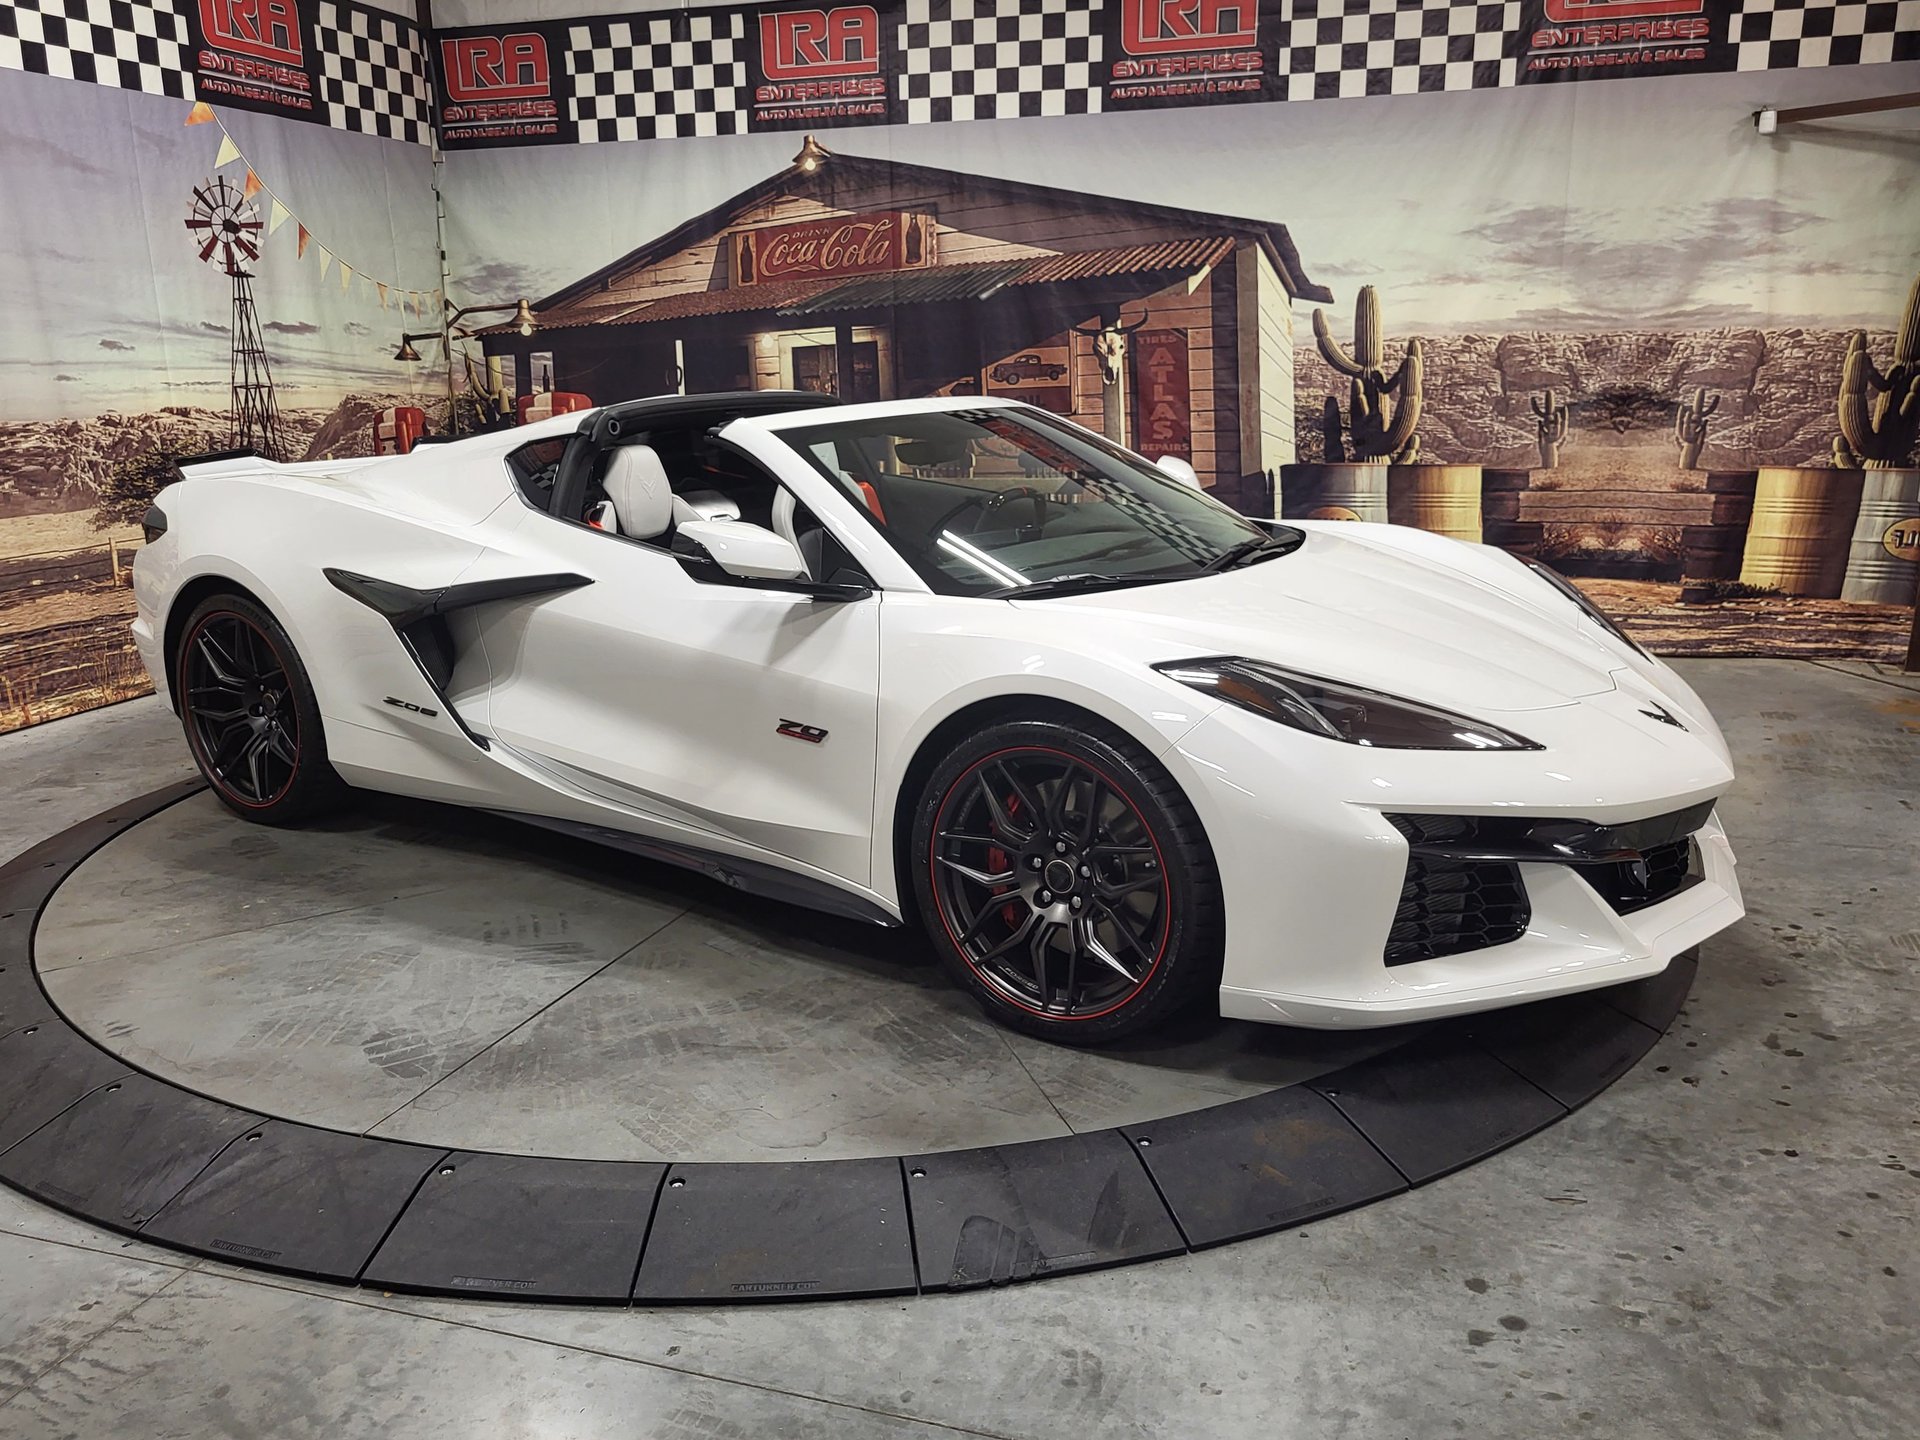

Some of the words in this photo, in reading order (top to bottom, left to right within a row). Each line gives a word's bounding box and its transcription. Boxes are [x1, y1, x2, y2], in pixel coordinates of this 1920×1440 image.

[758, 5, 880, 81] LRA
[1531, 18, 1710, 48] ENTERPRISES
[198, 50, 310, 90] ENTERPRISES
[441, 32, 551, 102] LRA
[1112, 51, 1263, 78] ENTERPRISES
[1527, 58, 1571, 71] AUTO
[1572, 52, 1639, 68] MUSEUM
[1654, 48, 1706, 62] SALES
[201, 79, 230, 94] AUTO
[756, 78, 885, 102] ENTERPRISES
[1110, 87, 1147, 99] AUTO
[1218, 79, 1261, 92] SALES
[444, 100, 557, 121] ENTERPRISES
[755, 110, 787, 121] AUTO
[444, 129, 472, 140] AUTO
[1137, 335, 1177, 345] TIRES
[1148, 347, 1178, 440] ATLAS
[1141, 443, 1189, 452] REPAIRS
